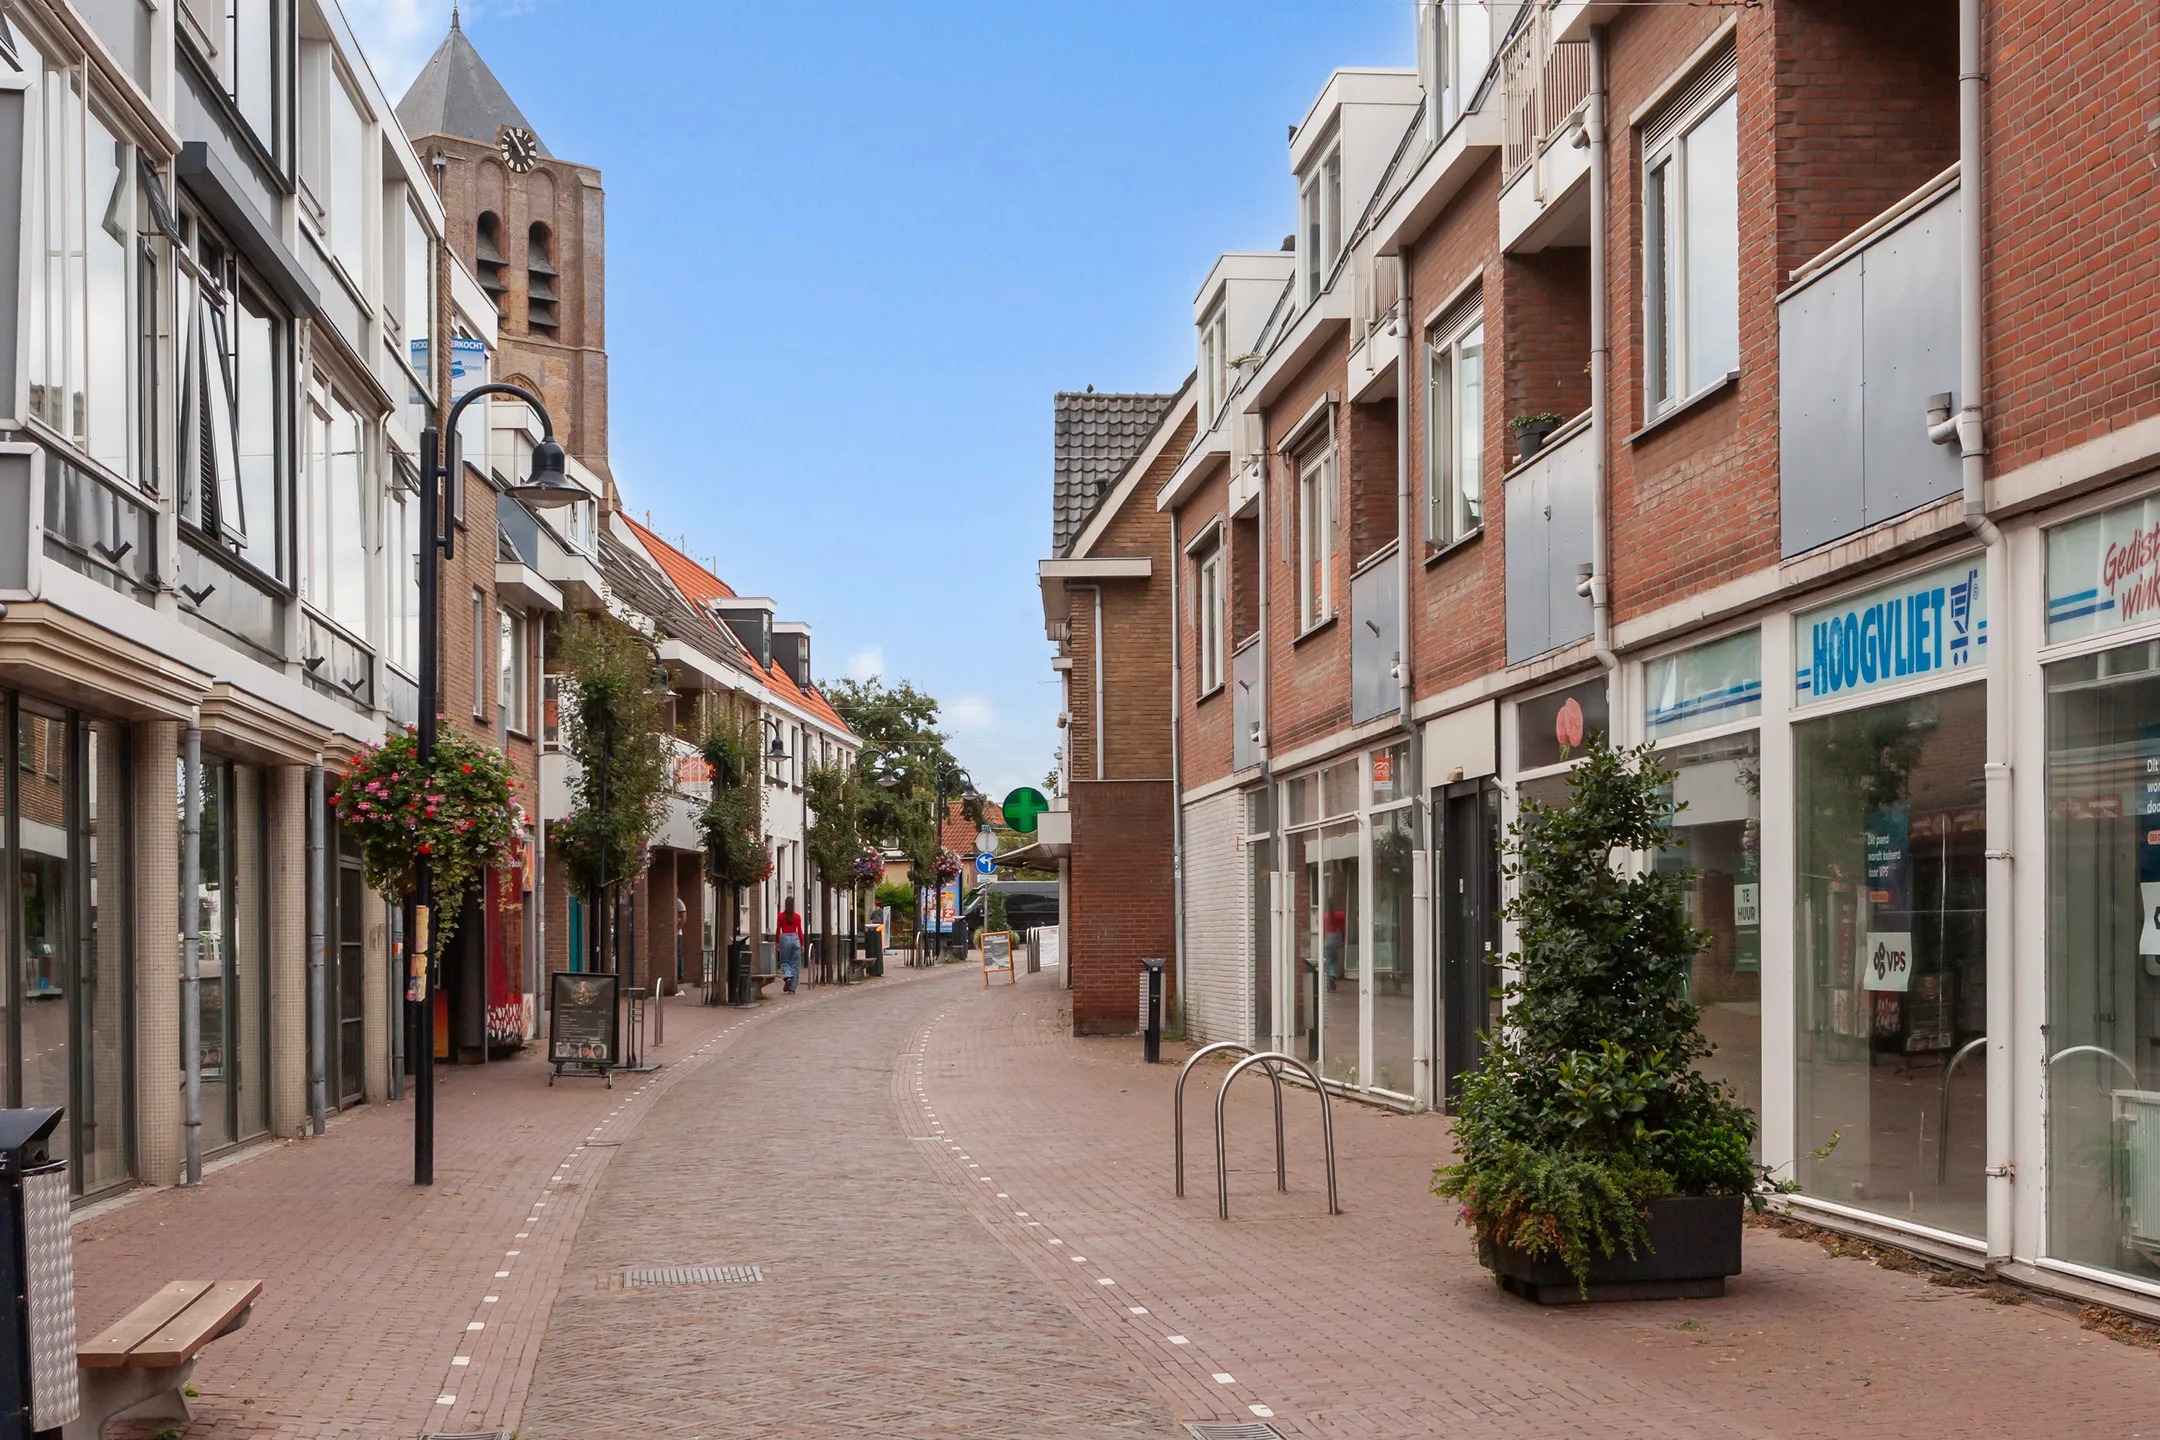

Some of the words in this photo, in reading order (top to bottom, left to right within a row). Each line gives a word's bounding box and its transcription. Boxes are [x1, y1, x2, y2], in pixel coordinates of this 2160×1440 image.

[1813, 587, 1945, 696] HOOGVLIET
[2147, 759, 2159, 773] Dit
[1876, 833, 1889, 848] pand
[1742, 888, 1750, 902] TE
[1737, 906, 1756, 921] HUUR
[1886, 951, 1906, 972] VPS
